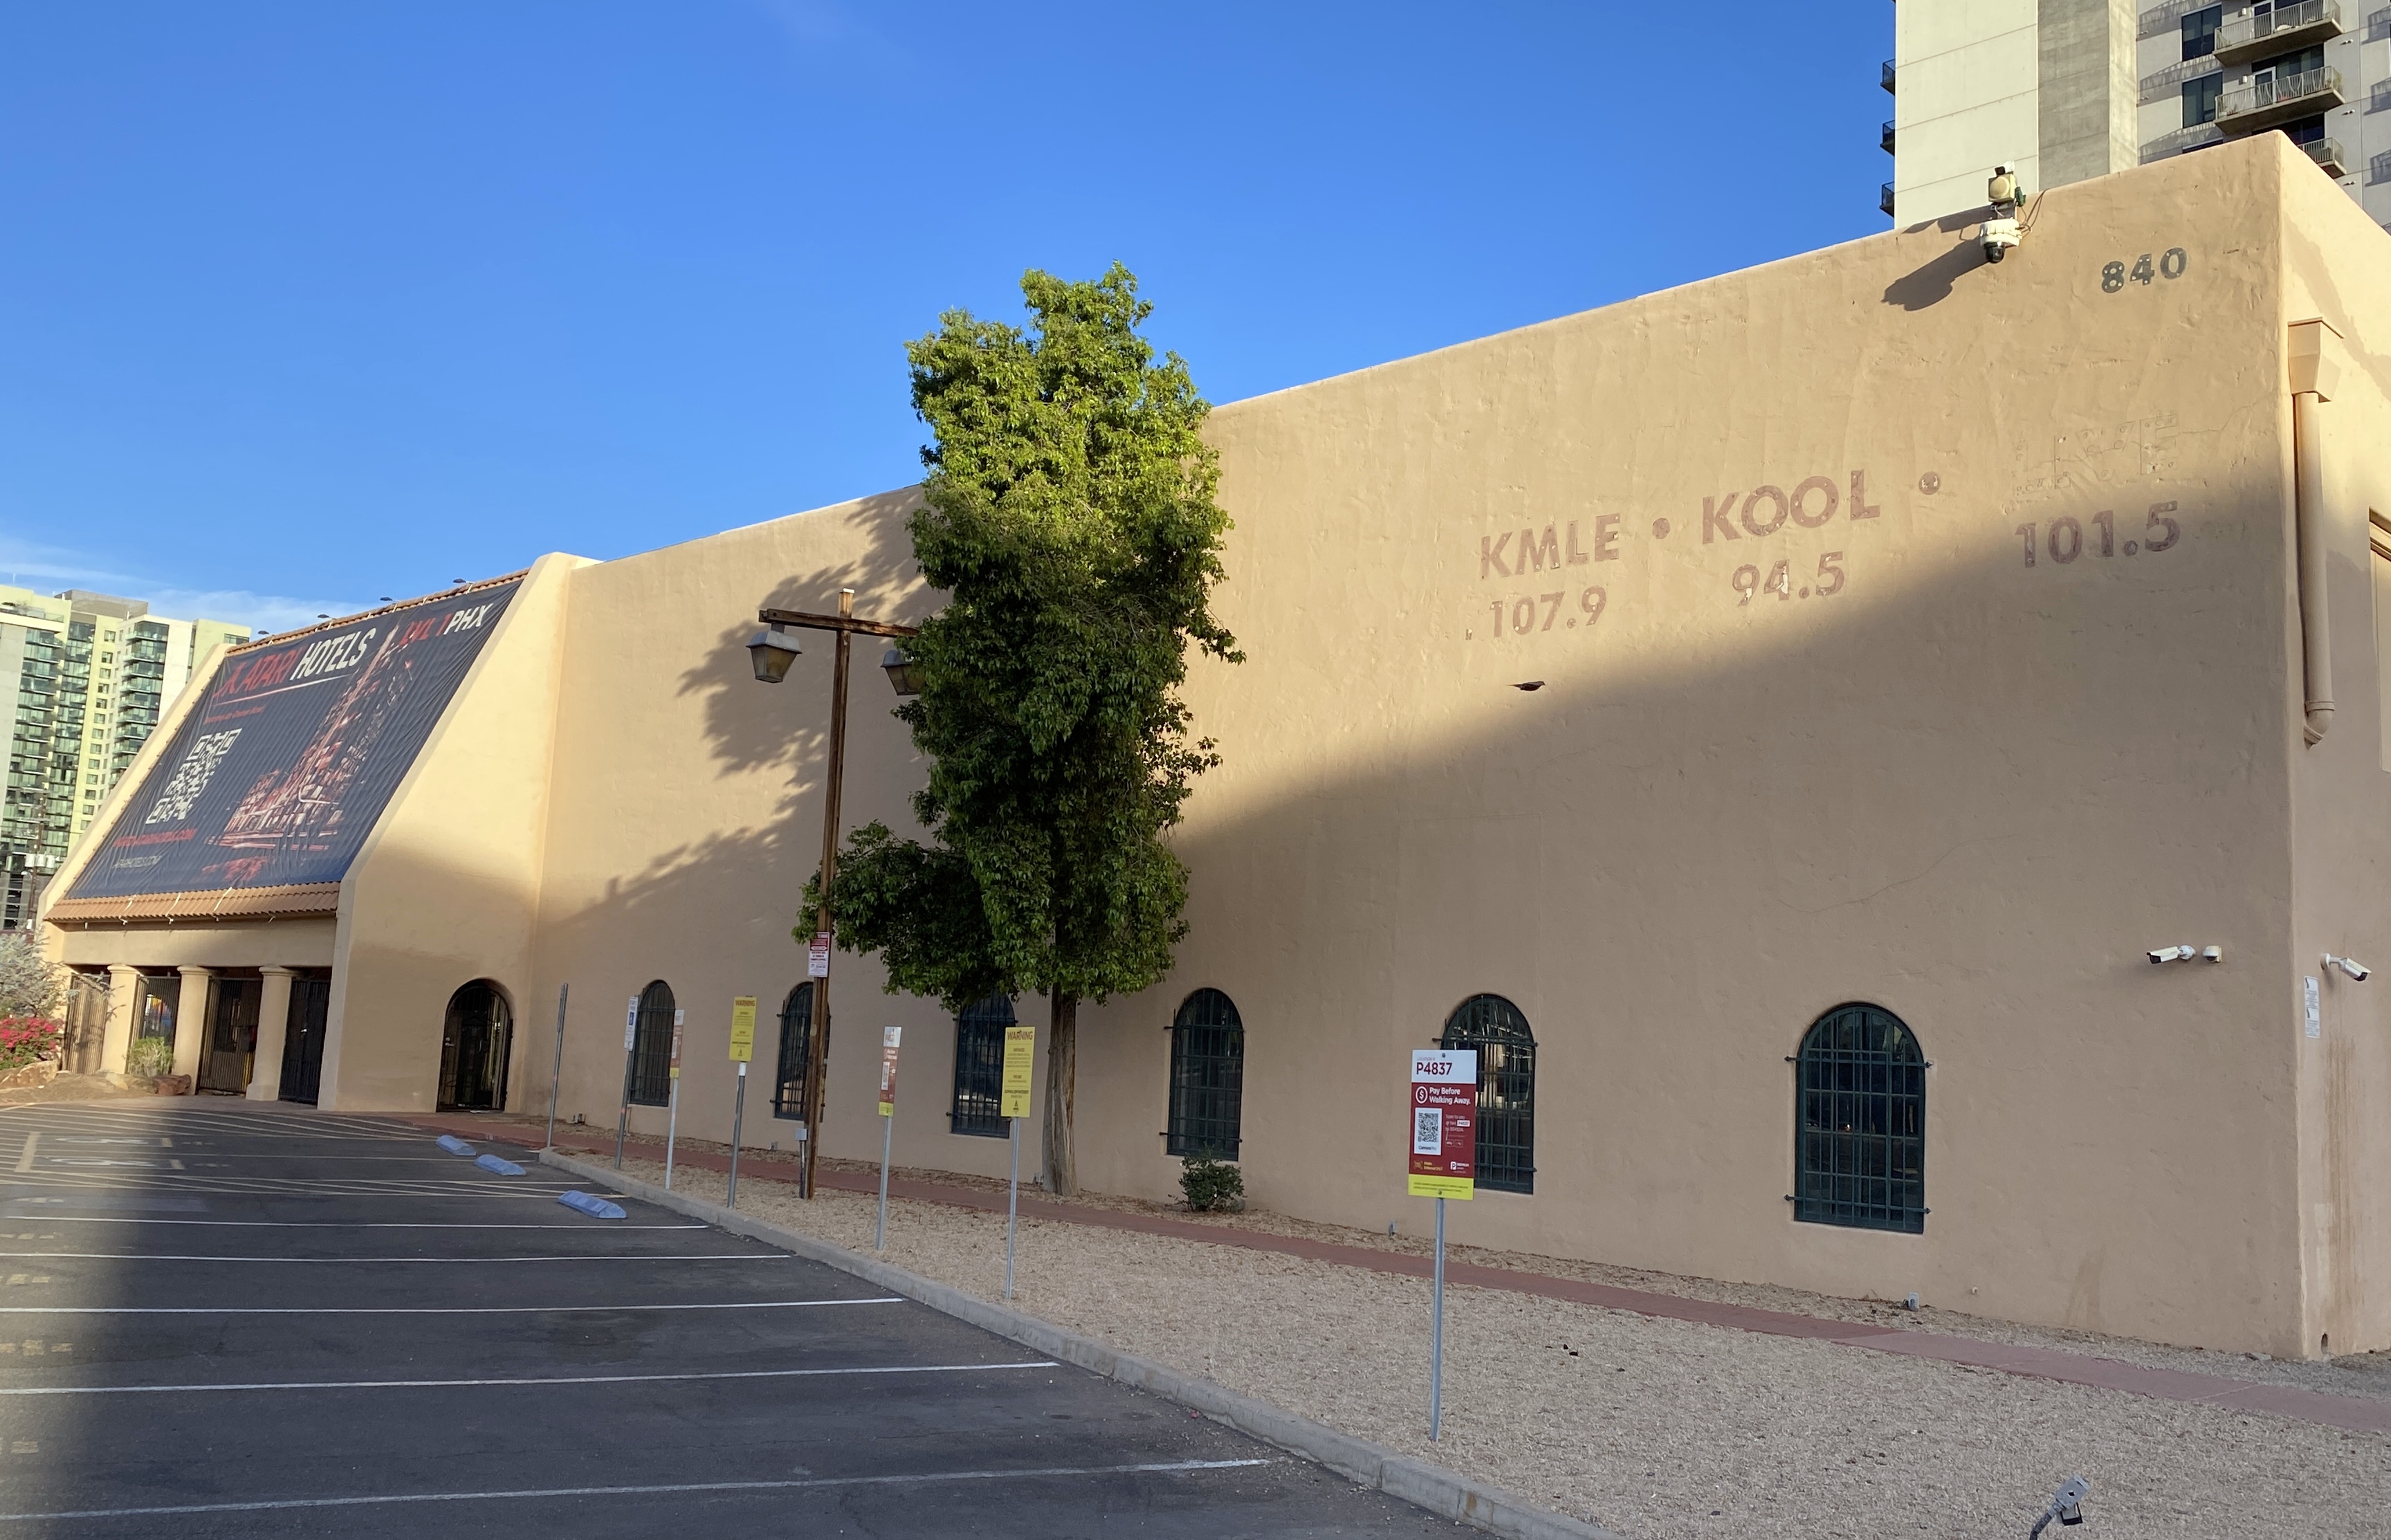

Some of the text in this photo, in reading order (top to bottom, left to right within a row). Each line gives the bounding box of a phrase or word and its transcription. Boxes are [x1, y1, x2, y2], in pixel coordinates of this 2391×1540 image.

[2101, 247, 2188, 293] 840
[1479, 469, 1880, 580] KMLE KOOL
[2015, 499, 2181, 568] 101.5
[1732, 551, 1845, 606] 94.5
[435, 612, 453, 636] 1
[443, 603, 494, 635] PHX
[1490, 585, 1606, 637] 107.9
[236, 627, 376, 694] ATARI HOTELS
[1007, 1031, 1033, 1041] WARNING
[1416, 1061, 1453, 1075] P4837
[1429, 1087, 1440, 1096] Pay
[1429, 1095, 1471, 1106] Walking Away.
